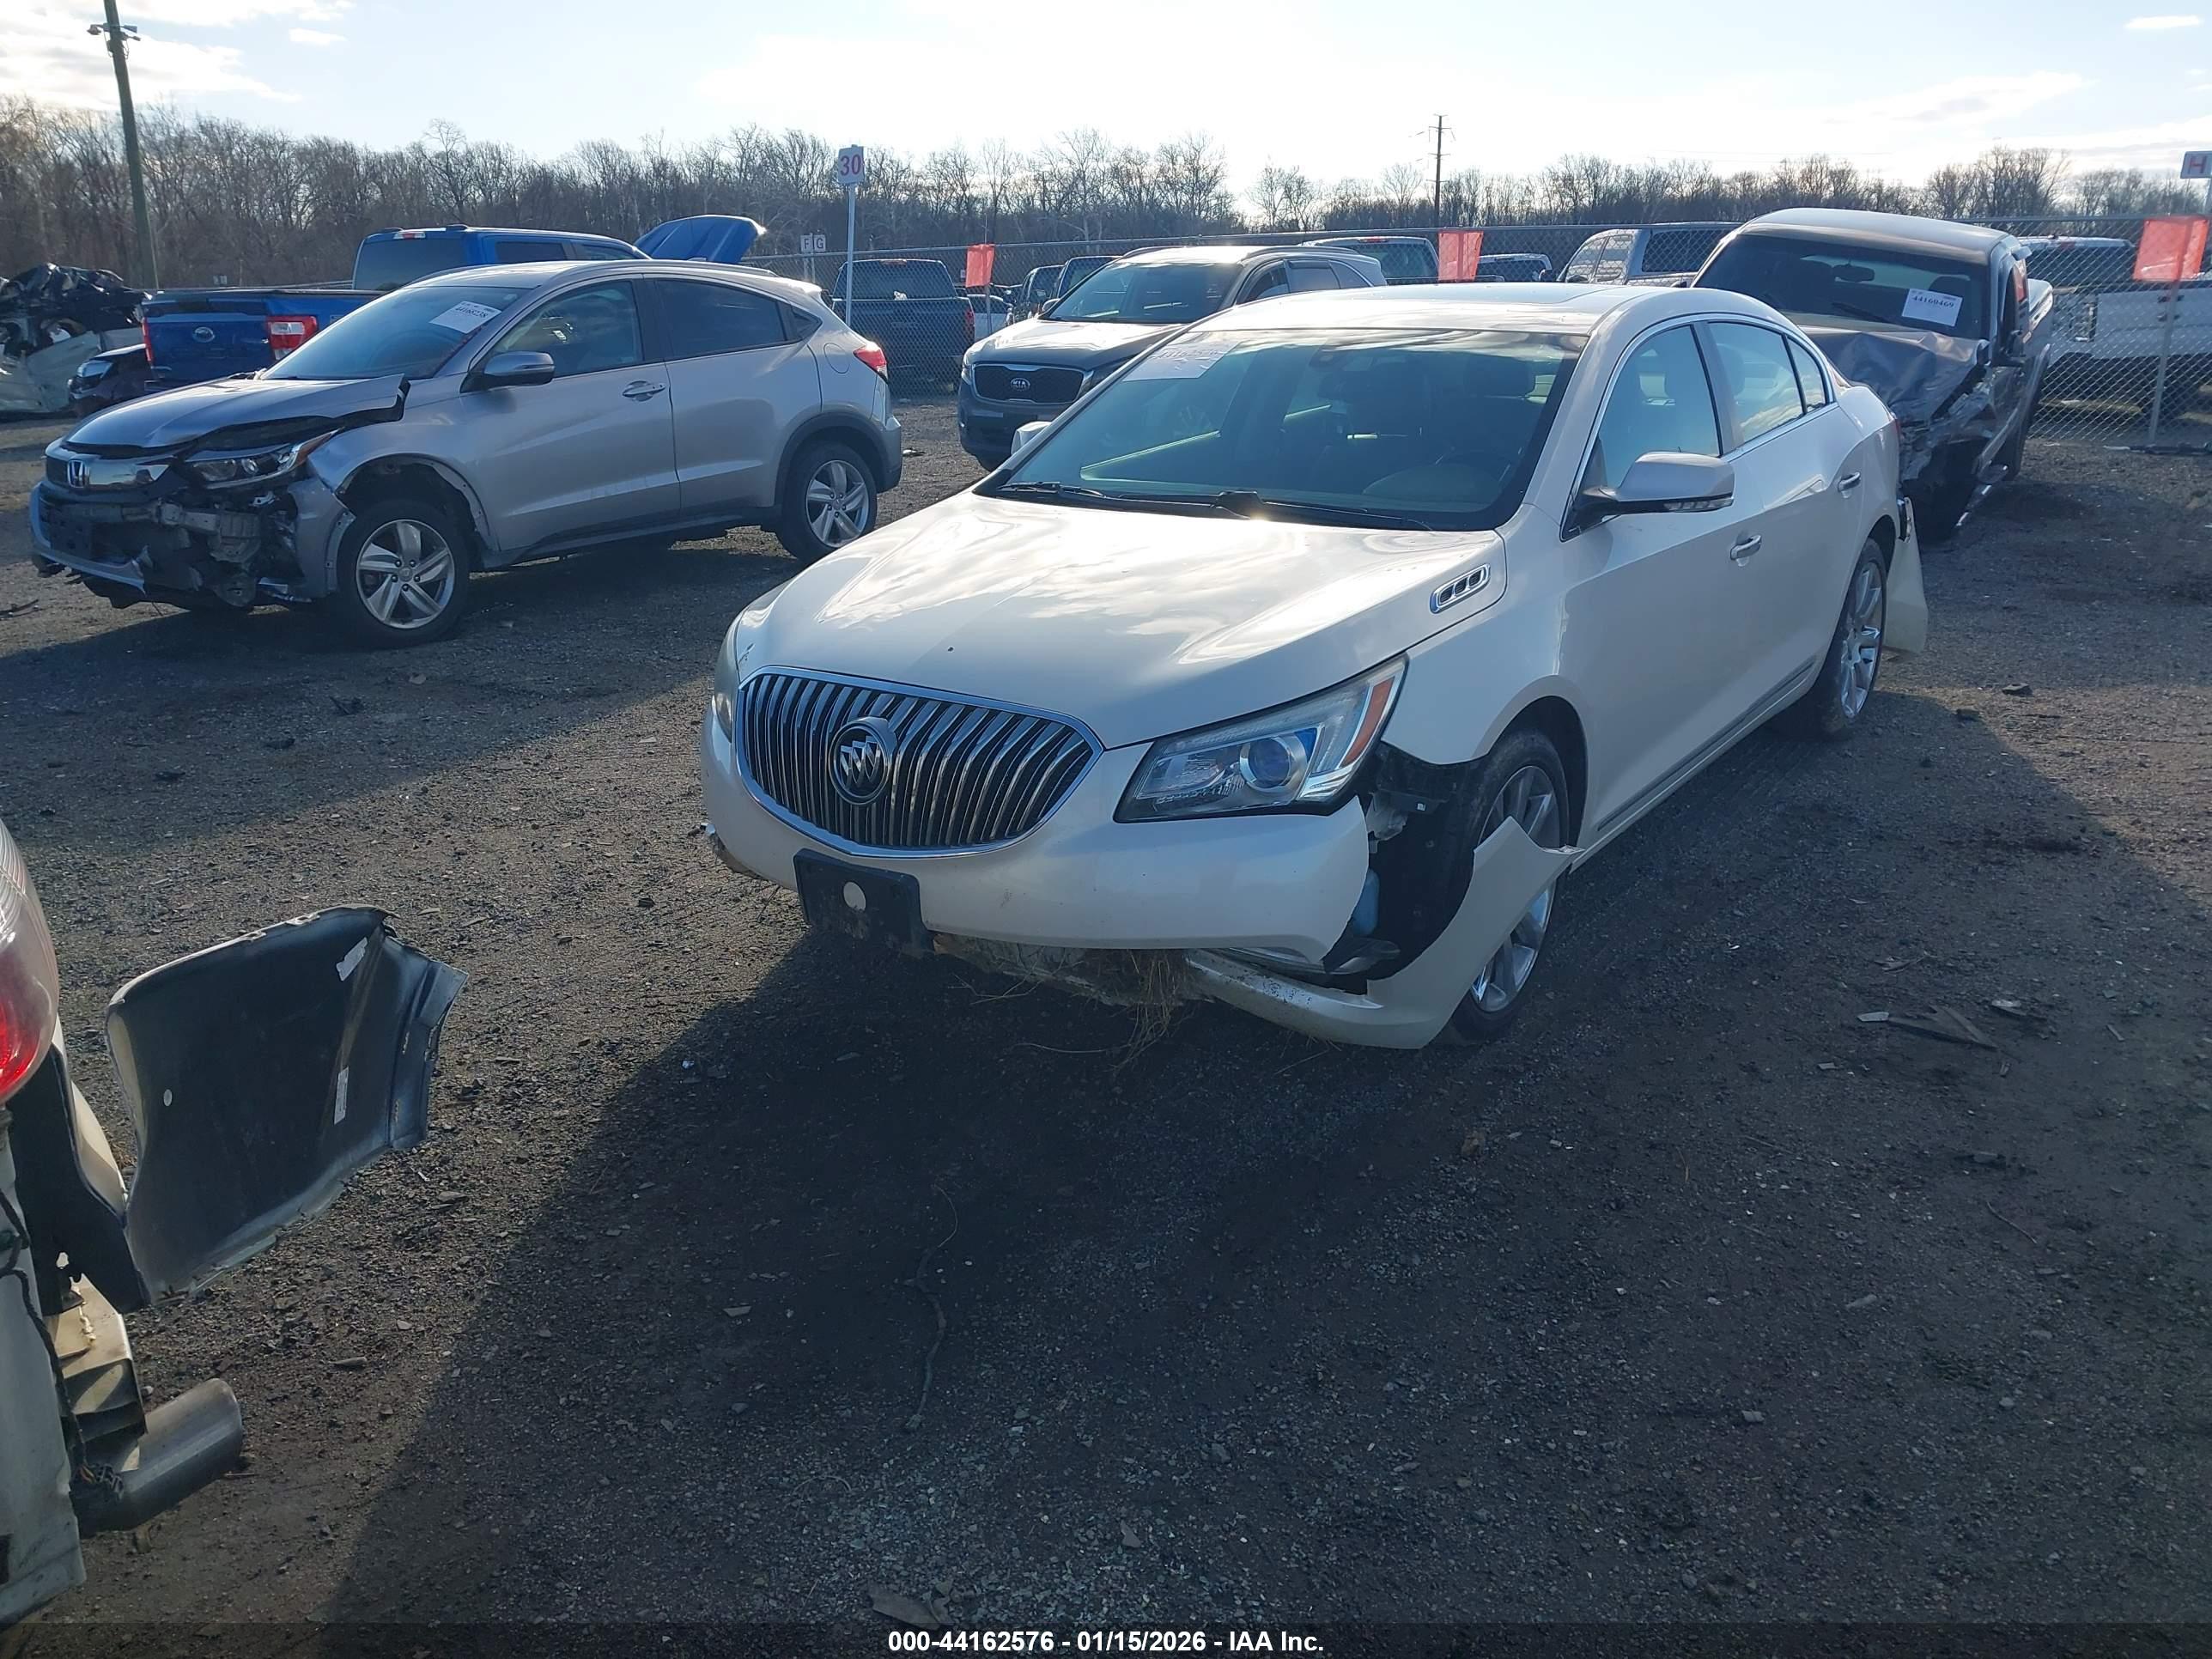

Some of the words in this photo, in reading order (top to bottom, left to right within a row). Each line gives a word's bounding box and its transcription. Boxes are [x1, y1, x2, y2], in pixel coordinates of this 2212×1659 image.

[840, 155, 861, 177] 30
[2187, 155, 2208, 174] H
[804, 238, 810, 249] F
[816, 237, 824, 249] G
